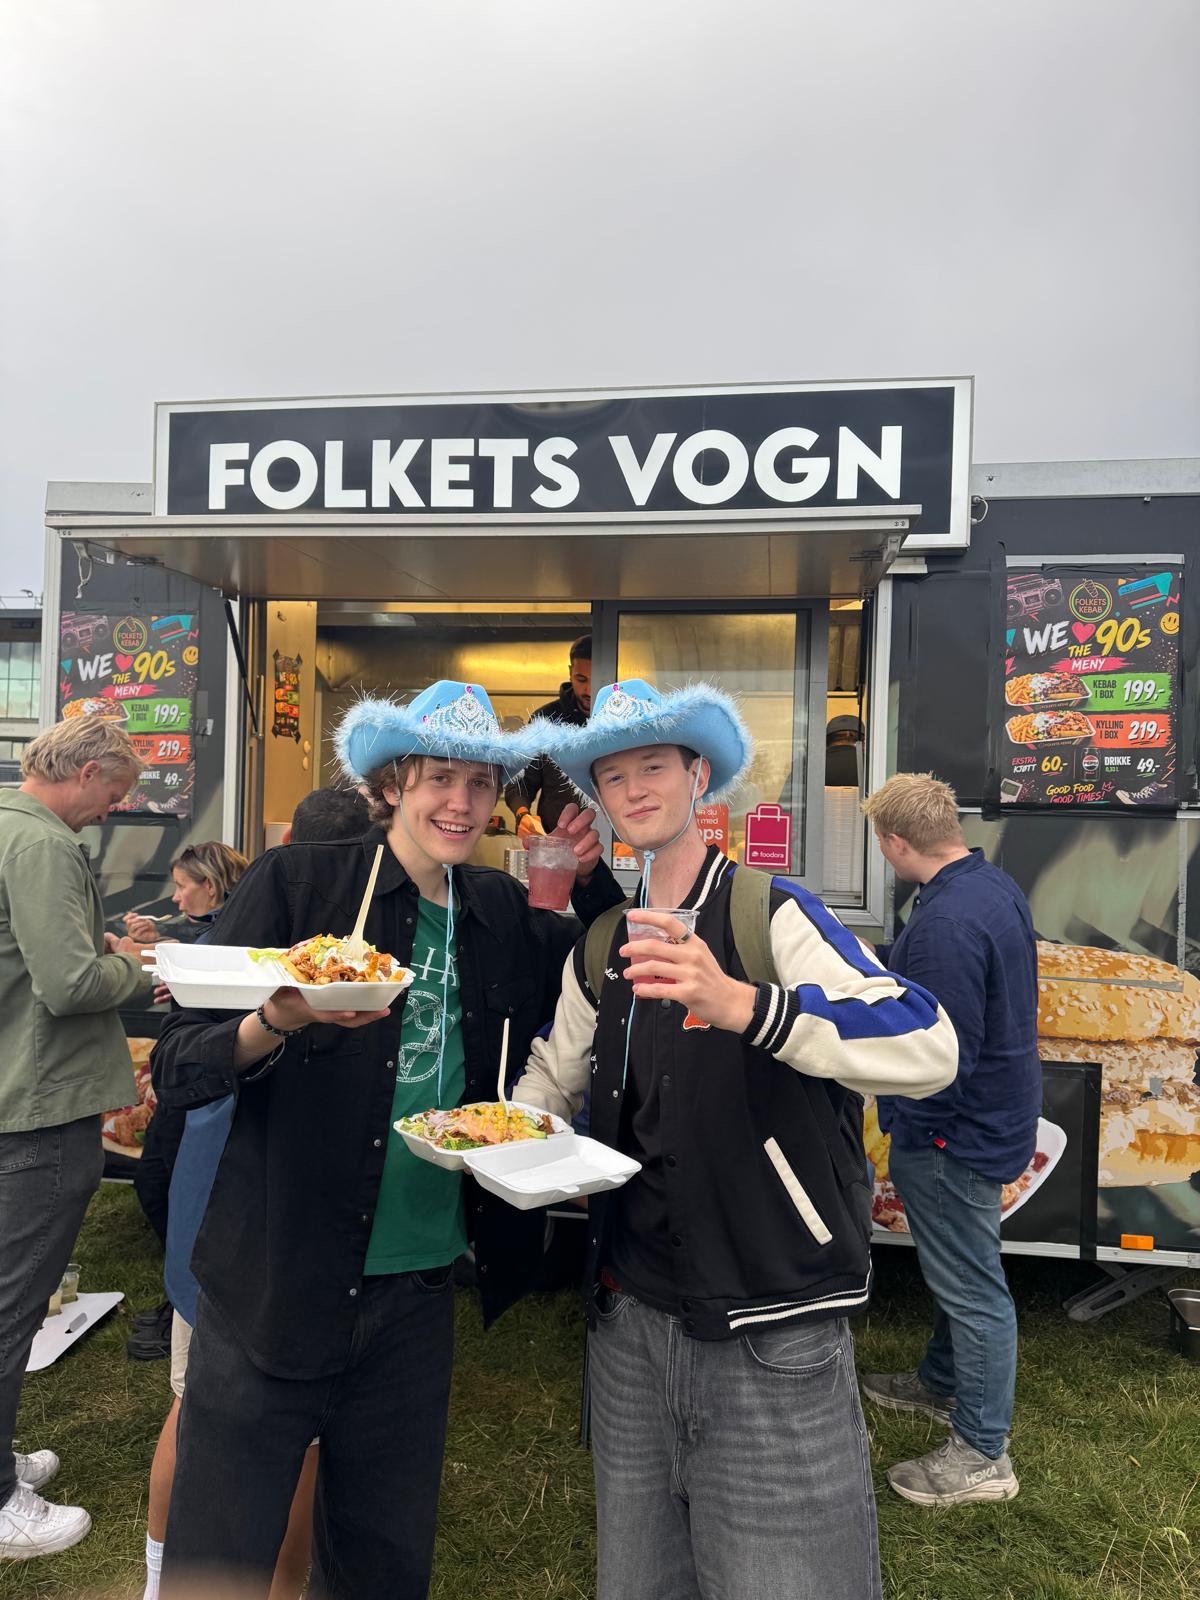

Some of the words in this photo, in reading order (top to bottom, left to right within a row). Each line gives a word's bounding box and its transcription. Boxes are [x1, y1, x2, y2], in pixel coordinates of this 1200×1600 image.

[208, 436, 580, 510] FOLKETS
[608, 425, 903, 506] VOGN
[1075, 598, 1107, 606] FOLKETS
[1078, 606, 1103, 614] KEBAB
[1023, 620, 1070, 655] WE
[1095, 617, 1152, 656] 90s
[1068, 643, 1092, 658] THE
[77, 652, 114, 681] WE
[133, 650, 176, 684] 90s
[1071, 658, 1106, 671] MENY
[112, 672, 132, 685] THE
[1093, 680, 1117, 689] KEBAB
[114, 685, 142, 697] MENY
[1099, 690, 1114, 699] BOX
[1123, 679, 1165, 702] 199,-
[1096, 720, 1124, 730] KYLLING
[1128, 720, 1166, 741] 219,-
[1104, 730, 1119, 739] BOX
[1011, 756, 1037, 766] EKSTRA
[1041, 756, 1068, 773] 60,-
[1105, 756, 1131, 766] DRIKKE
[1137, 758, 1160, 773] 49,-
[1046, 784, 1071, 796] GOOD
[1073, 783, 1095, 793] FOOD
[1077, 790, 1105, 802] TIMES!
[964, 1465, 998, 1487] HOKA
